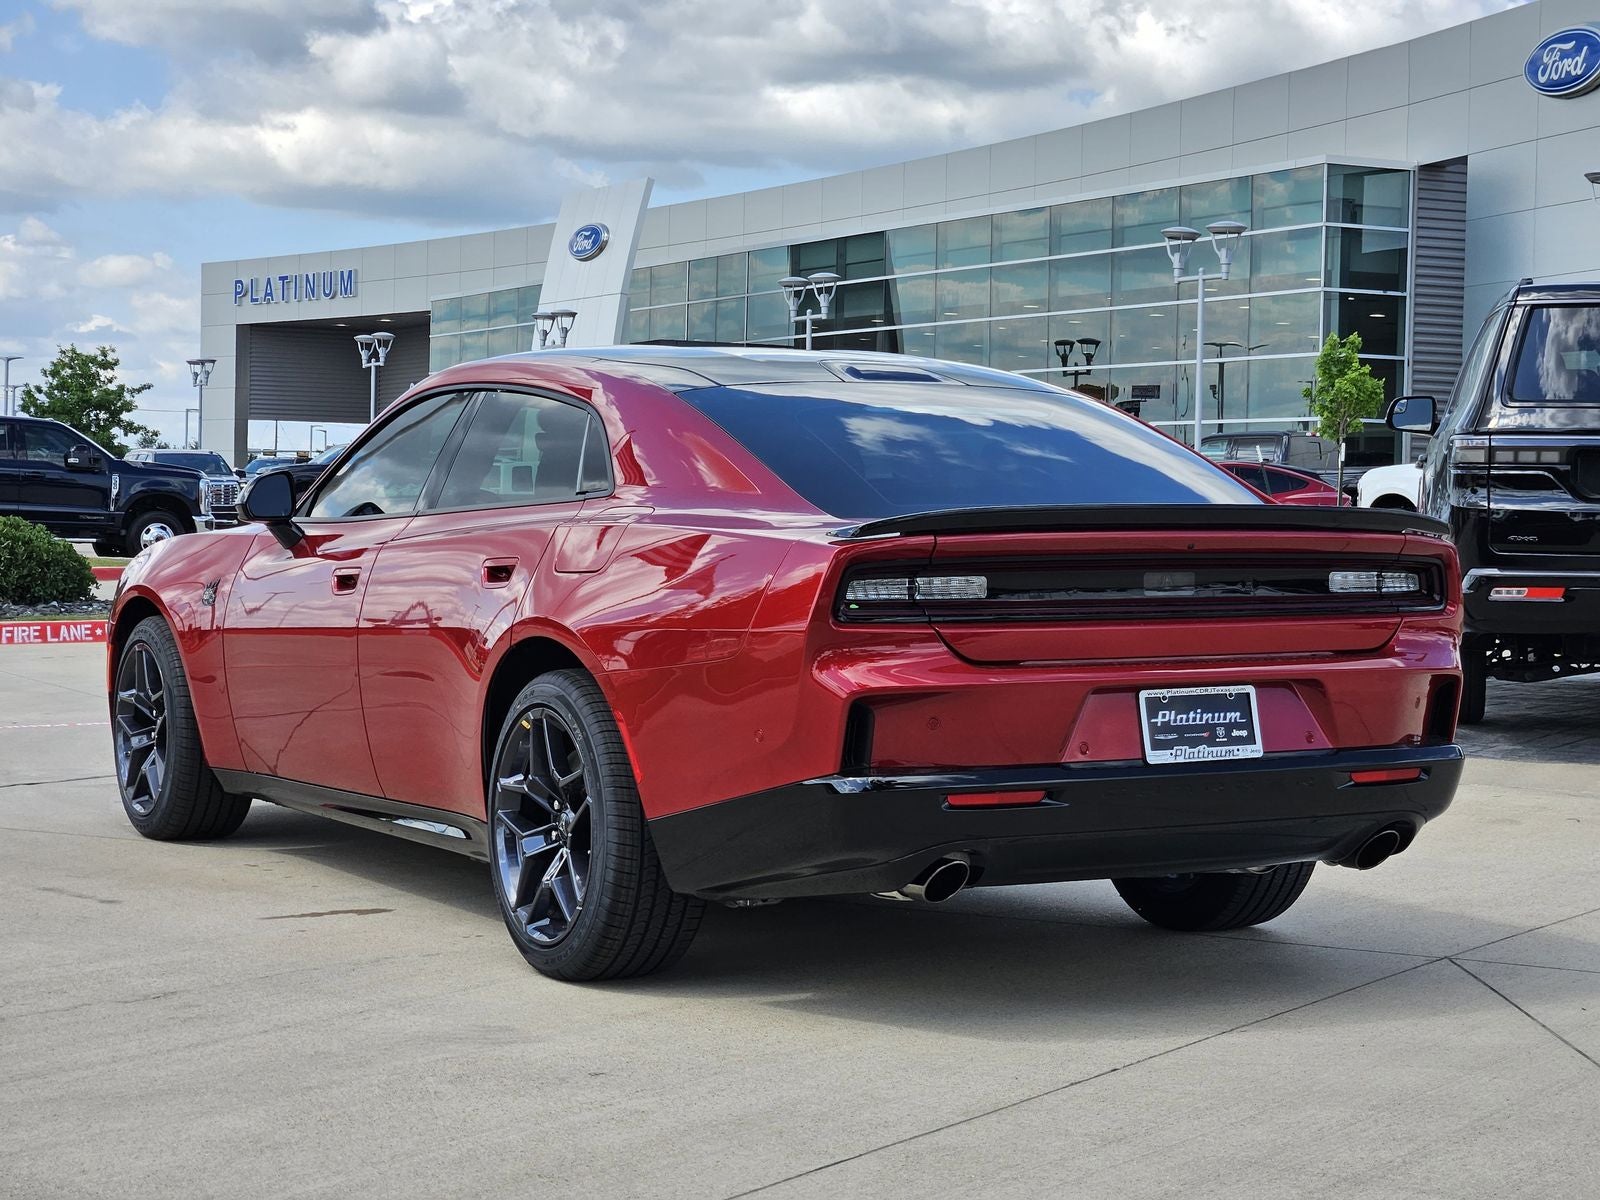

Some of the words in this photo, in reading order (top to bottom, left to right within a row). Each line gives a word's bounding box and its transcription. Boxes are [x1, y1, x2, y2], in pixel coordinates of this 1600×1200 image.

[1538, 40, 1588, 84] Ford
[573, 230, 596, 252] Ford
[233, 268, 356, 306] PLATINUM
[1, 625, 42, 644] FIRE
[46, 623, 94, 643] LANE
[1150, 709, 1246, 726] Platinum
[1231, 729, 1248, 738] Jeep
[1174, 746, 1238, 760] Platinum
